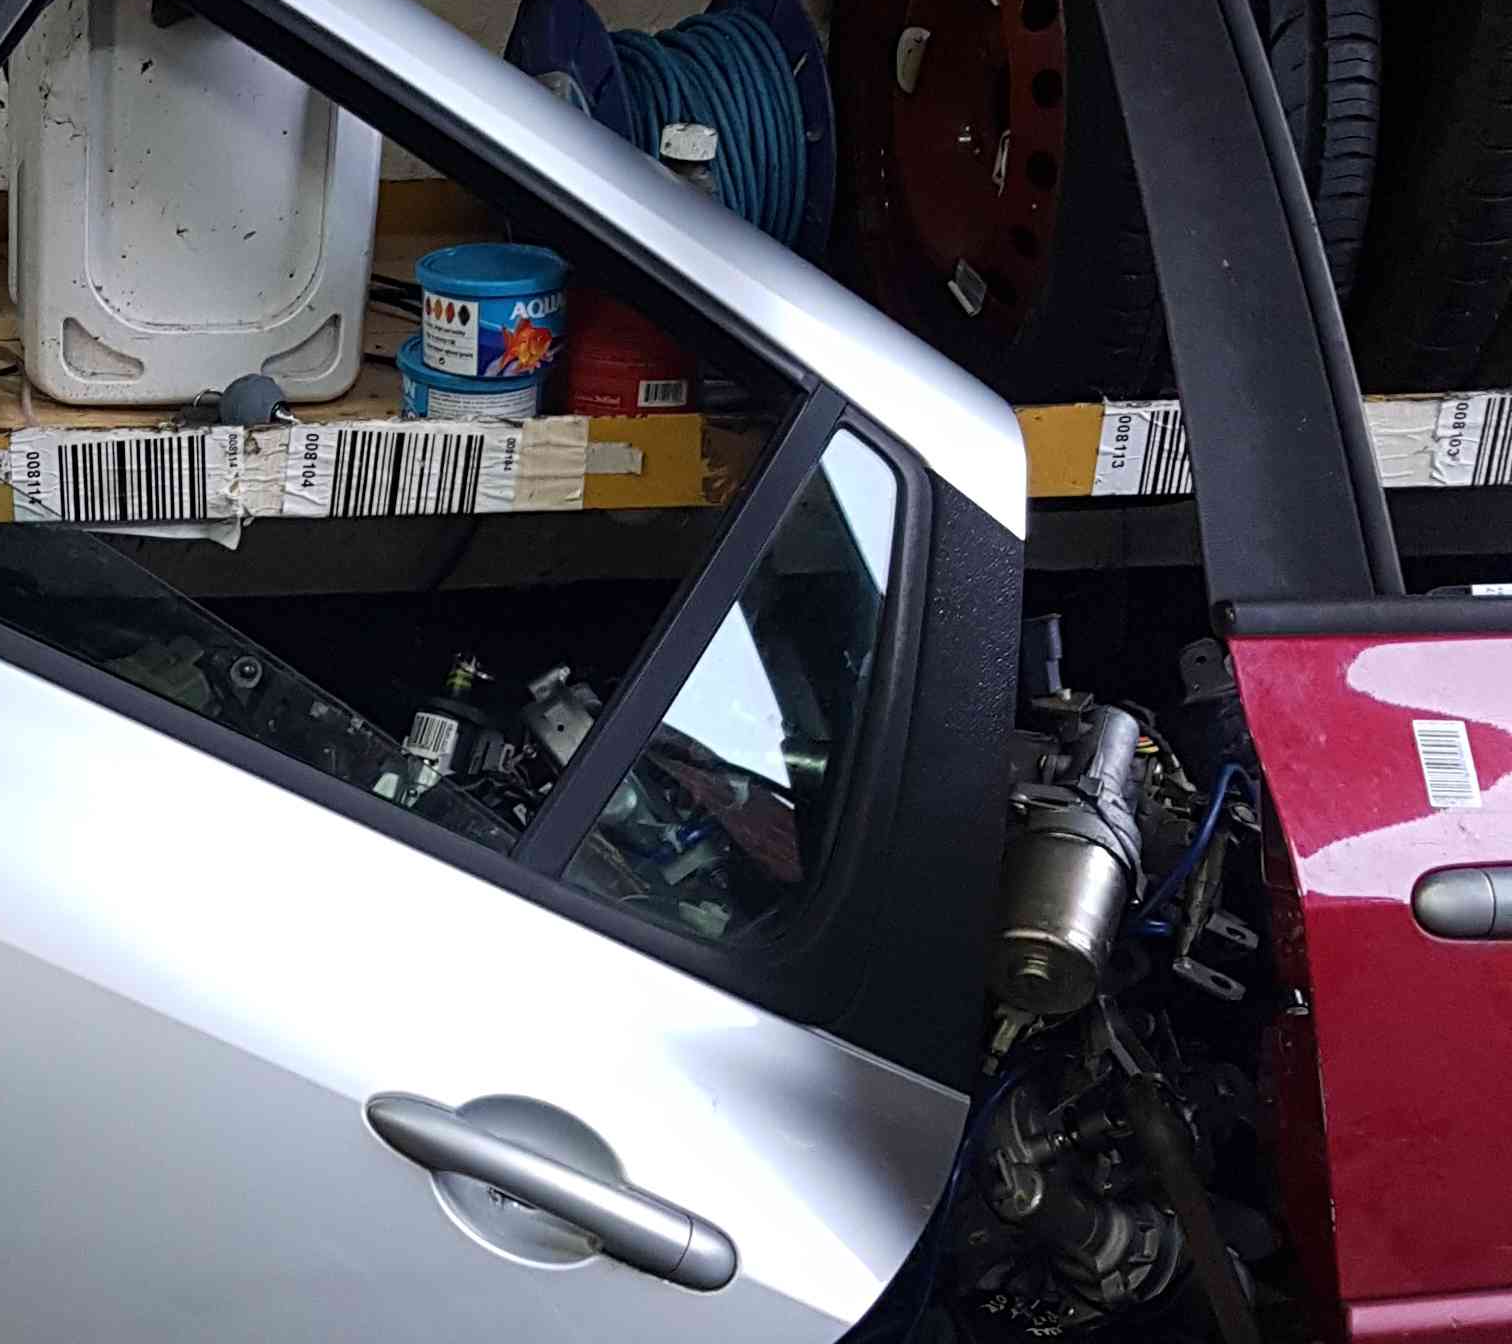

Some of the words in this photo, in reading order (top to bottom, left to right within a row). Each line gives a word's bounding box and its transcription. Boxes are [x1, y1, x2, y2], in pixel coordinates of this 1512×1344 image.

[1111, 415, 1132, 469] 008113
[1447, 402, 1470, 457] 008103
[27, 451, 43, 505] 008114
[301, 433, 320, 488] 008104
